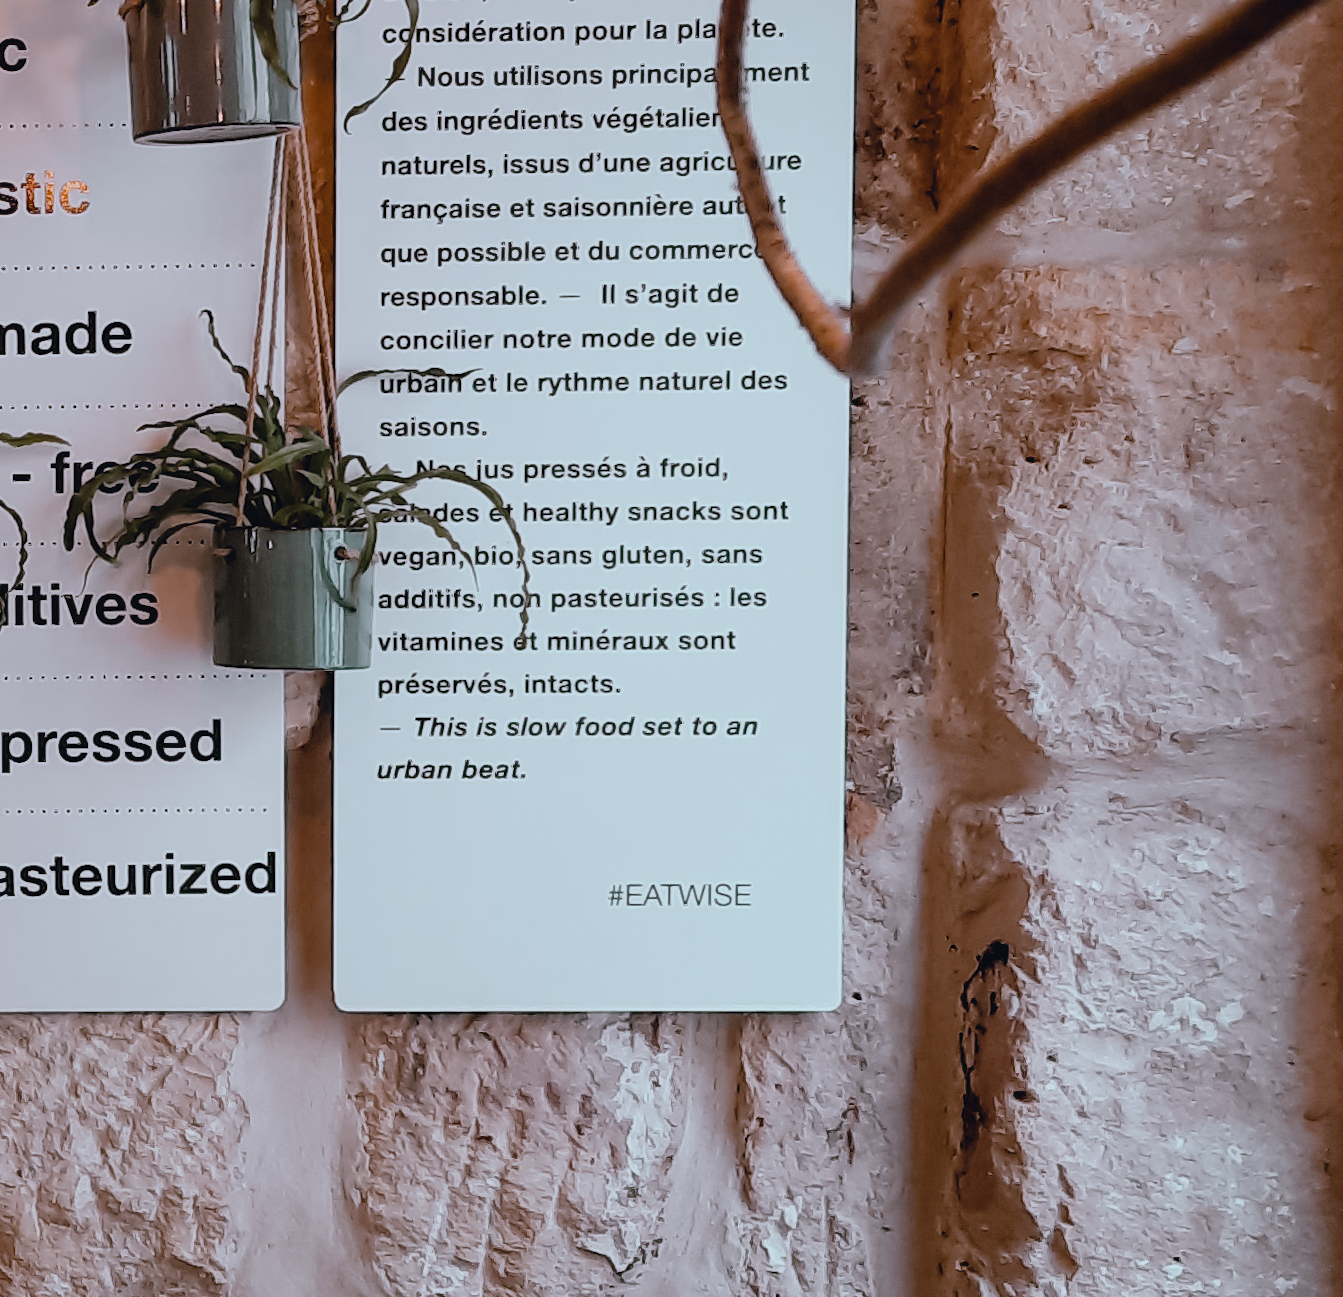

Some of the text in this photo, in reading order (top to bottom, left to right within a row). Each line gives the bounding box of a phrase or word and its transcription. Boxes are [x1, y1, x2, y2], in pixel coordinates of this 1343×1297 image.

[382, 18, 786, 46] considération pour la plate.
[417, 66, 485, 87] Nous
[493, 64, 603, 87] utilisons
[611, 63, 811, 89] principament
[381, 110, 428, 132] des
[437, 107, 584, 136] ingrédients
[381, 151, 803, 179] naturels, issus d’une agricuure
[380, 193, 787, 225] française et saisonnière autt
[380, 240, 763, 268] que possible et du commerc
[380, 284, 547, 311] responsable.
[602, 284, 616, 304] Il
[625, 282, 699, 309] s’agit
[707, 282, 739, 303] de
[380, 326, 743, 351] concilier notre mode de vie
[380, 370, 788, 397] urbain et le rythme naturel des
[379, 417, 487, 437] saisons.
[12, 473, 32, 483] -
[476, 459, 514, 480] jus
[524, 456, 627, 484] pressés
[636, 456, 650, 478] à
[659, 457, 728, 481] froid,
[489, 503, 513, 522] et
[523, 501, 619, 526] healthy
[628, 500, 721, 522] snacks
[731, 501, 789, 521] sont
[378, 544, 763, 570] vegan, bio, sans gluten, sans
[378, 588, 483, 613] additifs,
[493, 593, 541, 608] non
[551, 586, 704, 613] pasteurisés
[730, 587, 767, 607] les
[377, 630, 736, 652] vitamines et minéraux sont
[378, 673, 621, 699] préservés, intacts.
[414, 716, 468, 737] This
[476, 716, 497, 737] is
[506, 716, 567, 737] slow
[575, 716, 636, 736] food
[642, 716, 683, 736] set
[692, 717, 717, 736] to
[726, 720, 758, 736] an
[0, 718, 222, 774] pressed
[376, 759, 526, 780] urban beat.
[609, 883, 751, 907] #EATWISE
